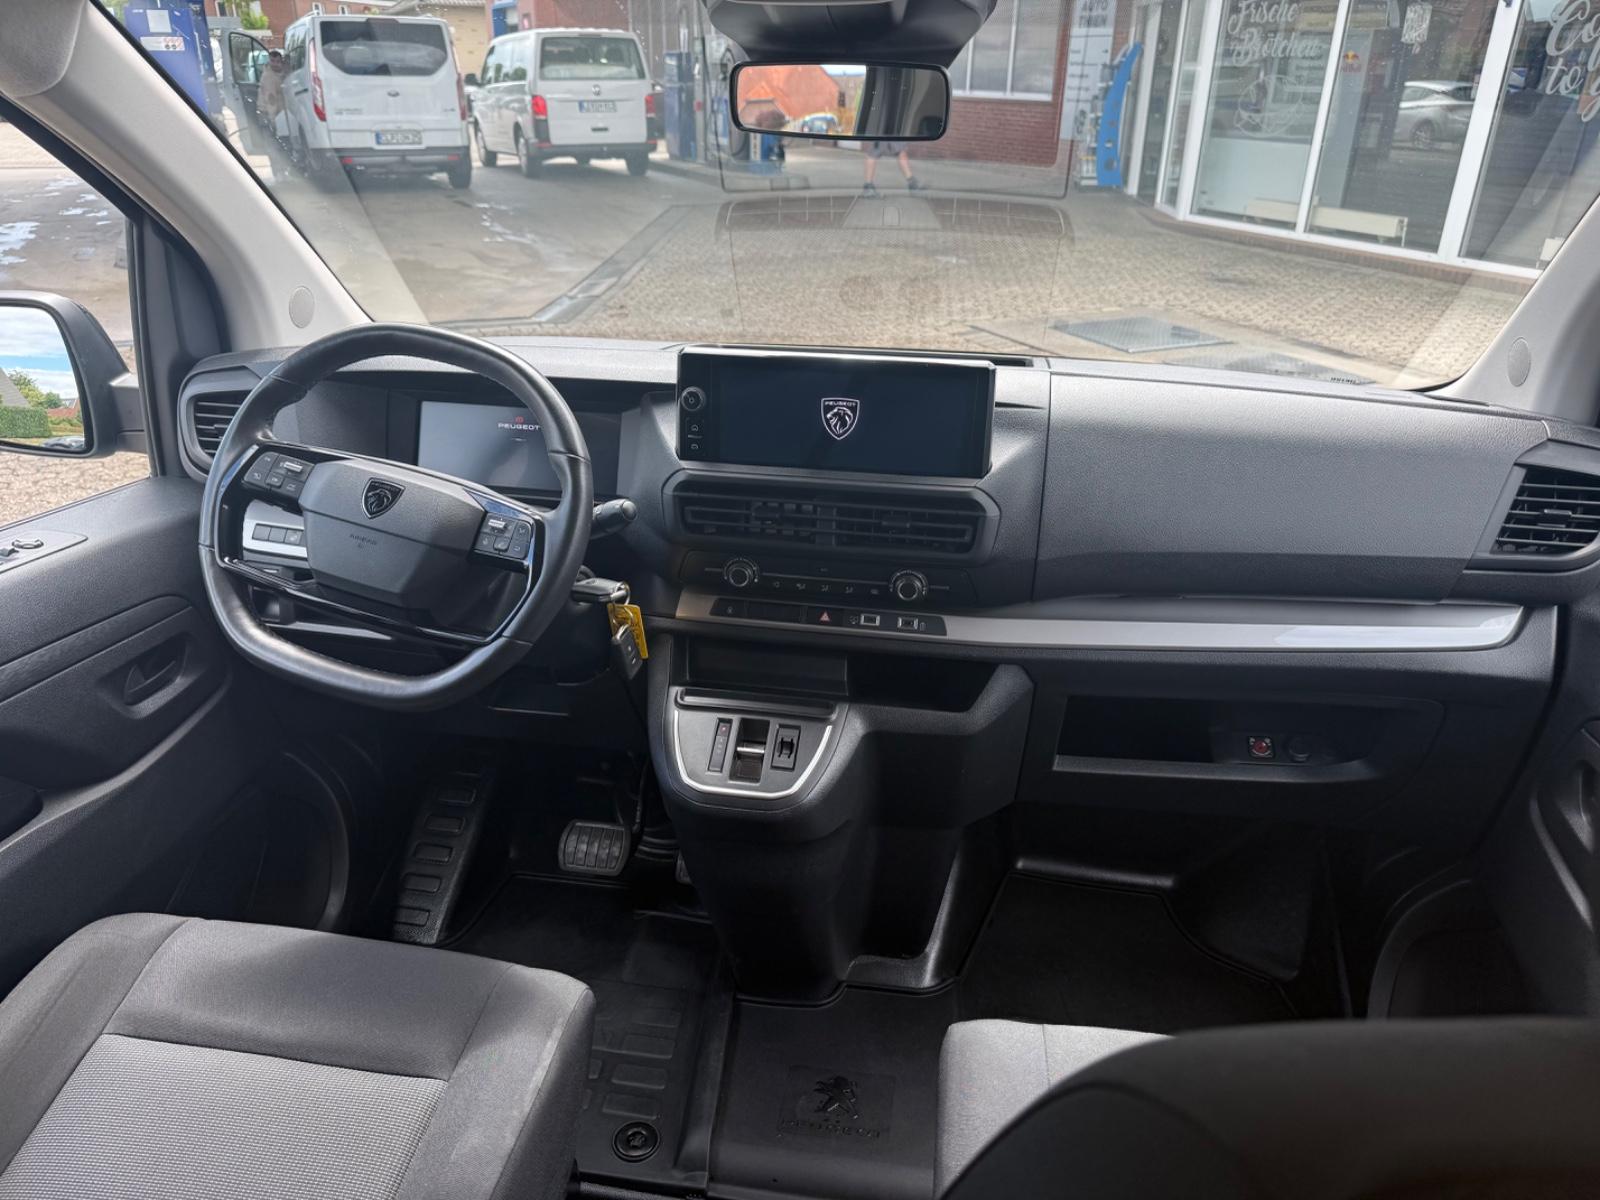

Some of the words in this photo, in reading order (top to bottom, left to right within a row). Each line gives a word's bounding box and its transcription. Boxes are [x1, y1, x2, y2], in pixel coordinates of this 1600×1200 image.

[1227, 0, 1299, 34] Frische
[1230, 28, 1326, 67] Brötchen
[1545, 57, 1584, 95] to
[497, 423, 541, 431] PEUGEOT
